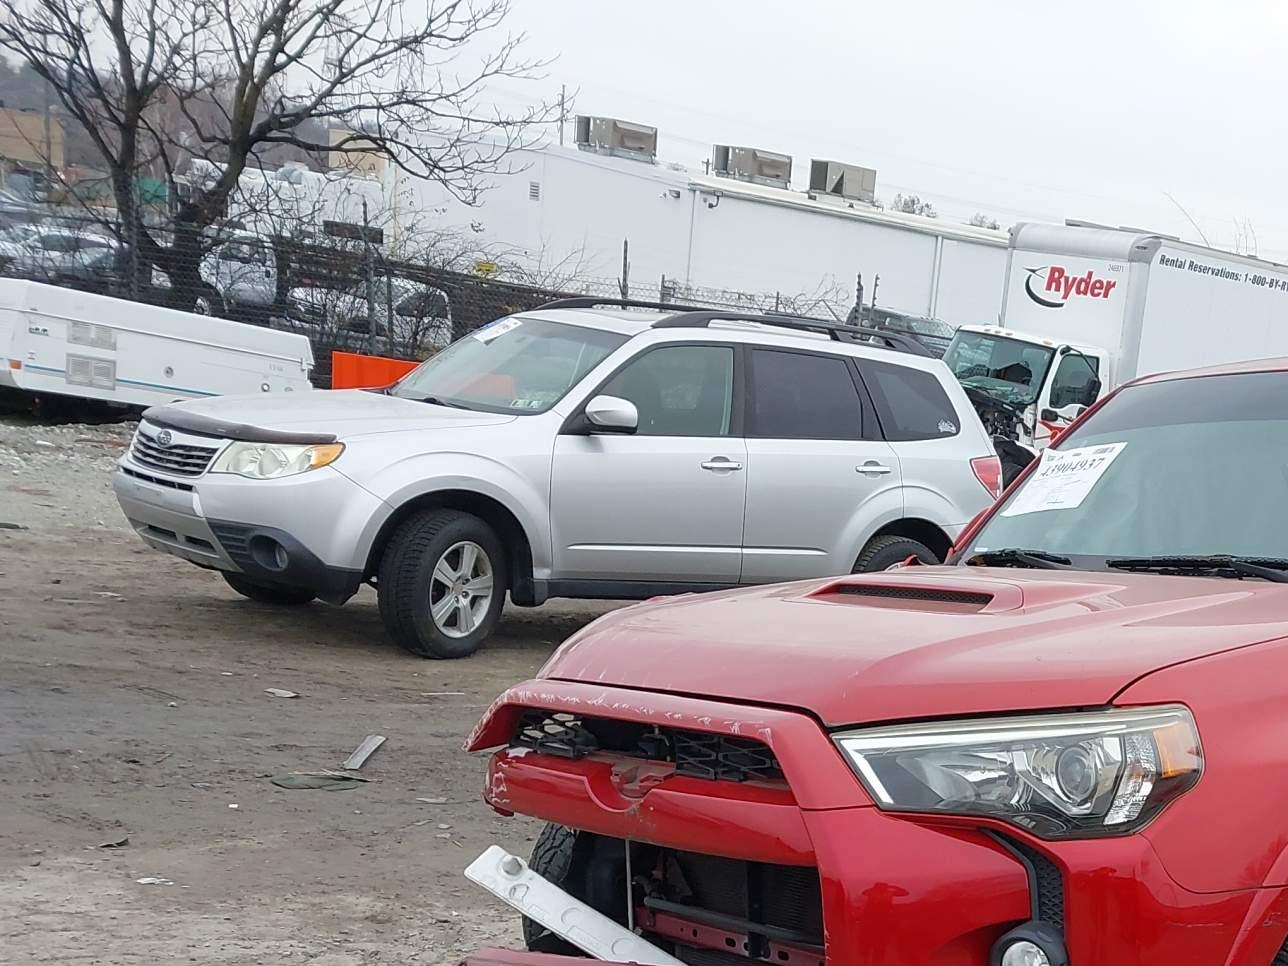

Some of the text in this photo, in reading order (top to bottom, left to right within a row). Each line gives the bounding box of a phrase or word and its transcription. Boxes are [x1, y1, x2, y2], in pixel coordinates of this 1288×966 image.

[1045, 266, 1117, 299] Ryder
[1159, 254, 1187, 269] Rental
[1188, 260, 1242, 282] Reservations:
